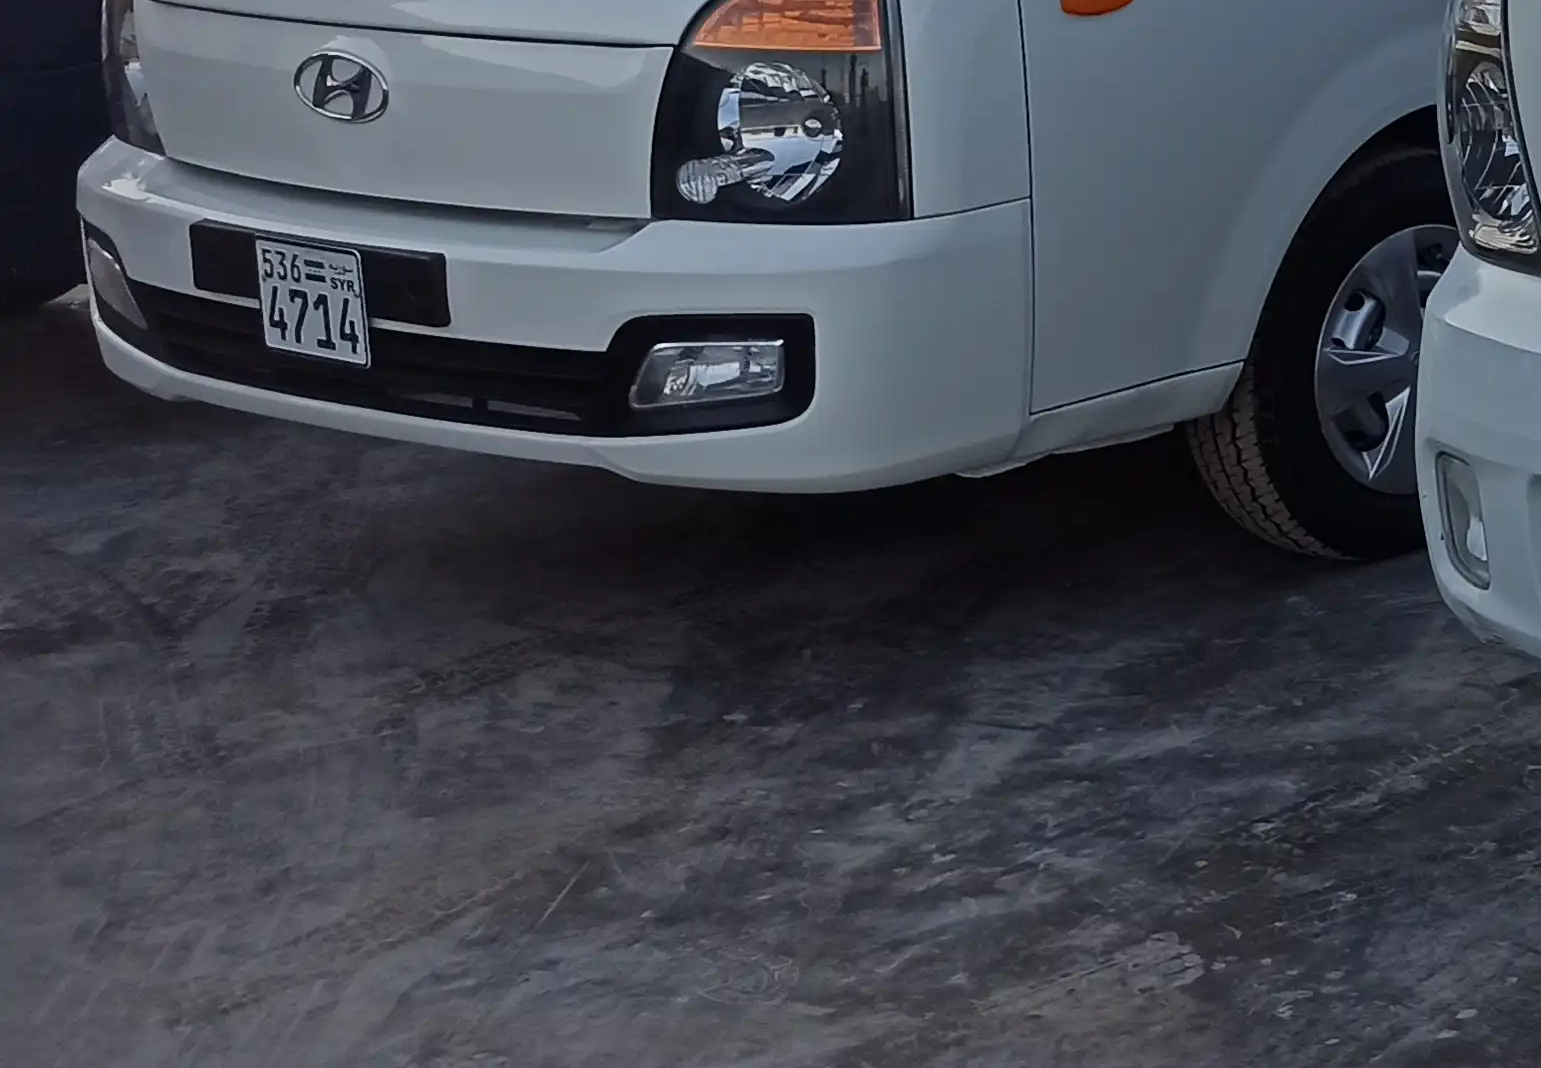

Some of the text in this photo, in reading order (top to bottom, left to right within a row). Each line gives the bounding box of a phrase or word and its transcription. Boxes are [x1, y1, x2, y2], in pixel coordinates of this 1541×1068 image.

[260, 248, 301, 283] 536
[330, 277, 356, 293] SYR
[268, 285, 359, 355] 4714
